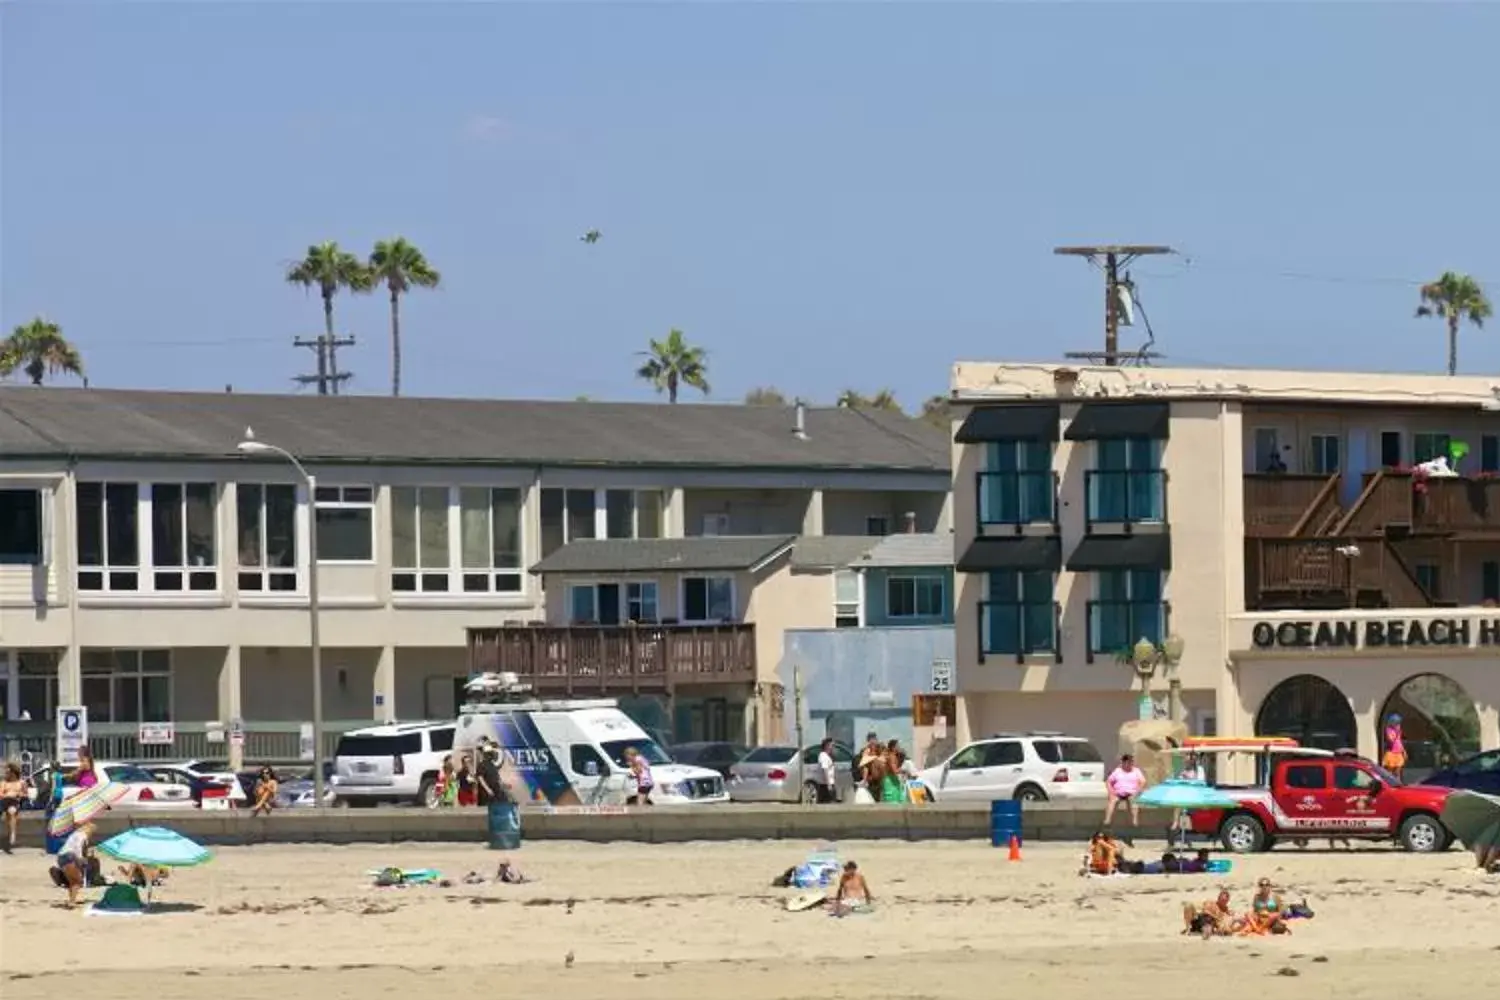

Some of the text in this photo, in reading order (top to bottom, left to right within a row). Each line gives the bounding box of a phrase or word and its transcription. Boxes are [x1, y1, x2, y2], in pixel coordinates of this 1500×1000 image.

[1252, 620, 1358, 647] OCEAN
[1365, 619, 1470, 646] BEACH
[933, 677, 949, 691] 25
